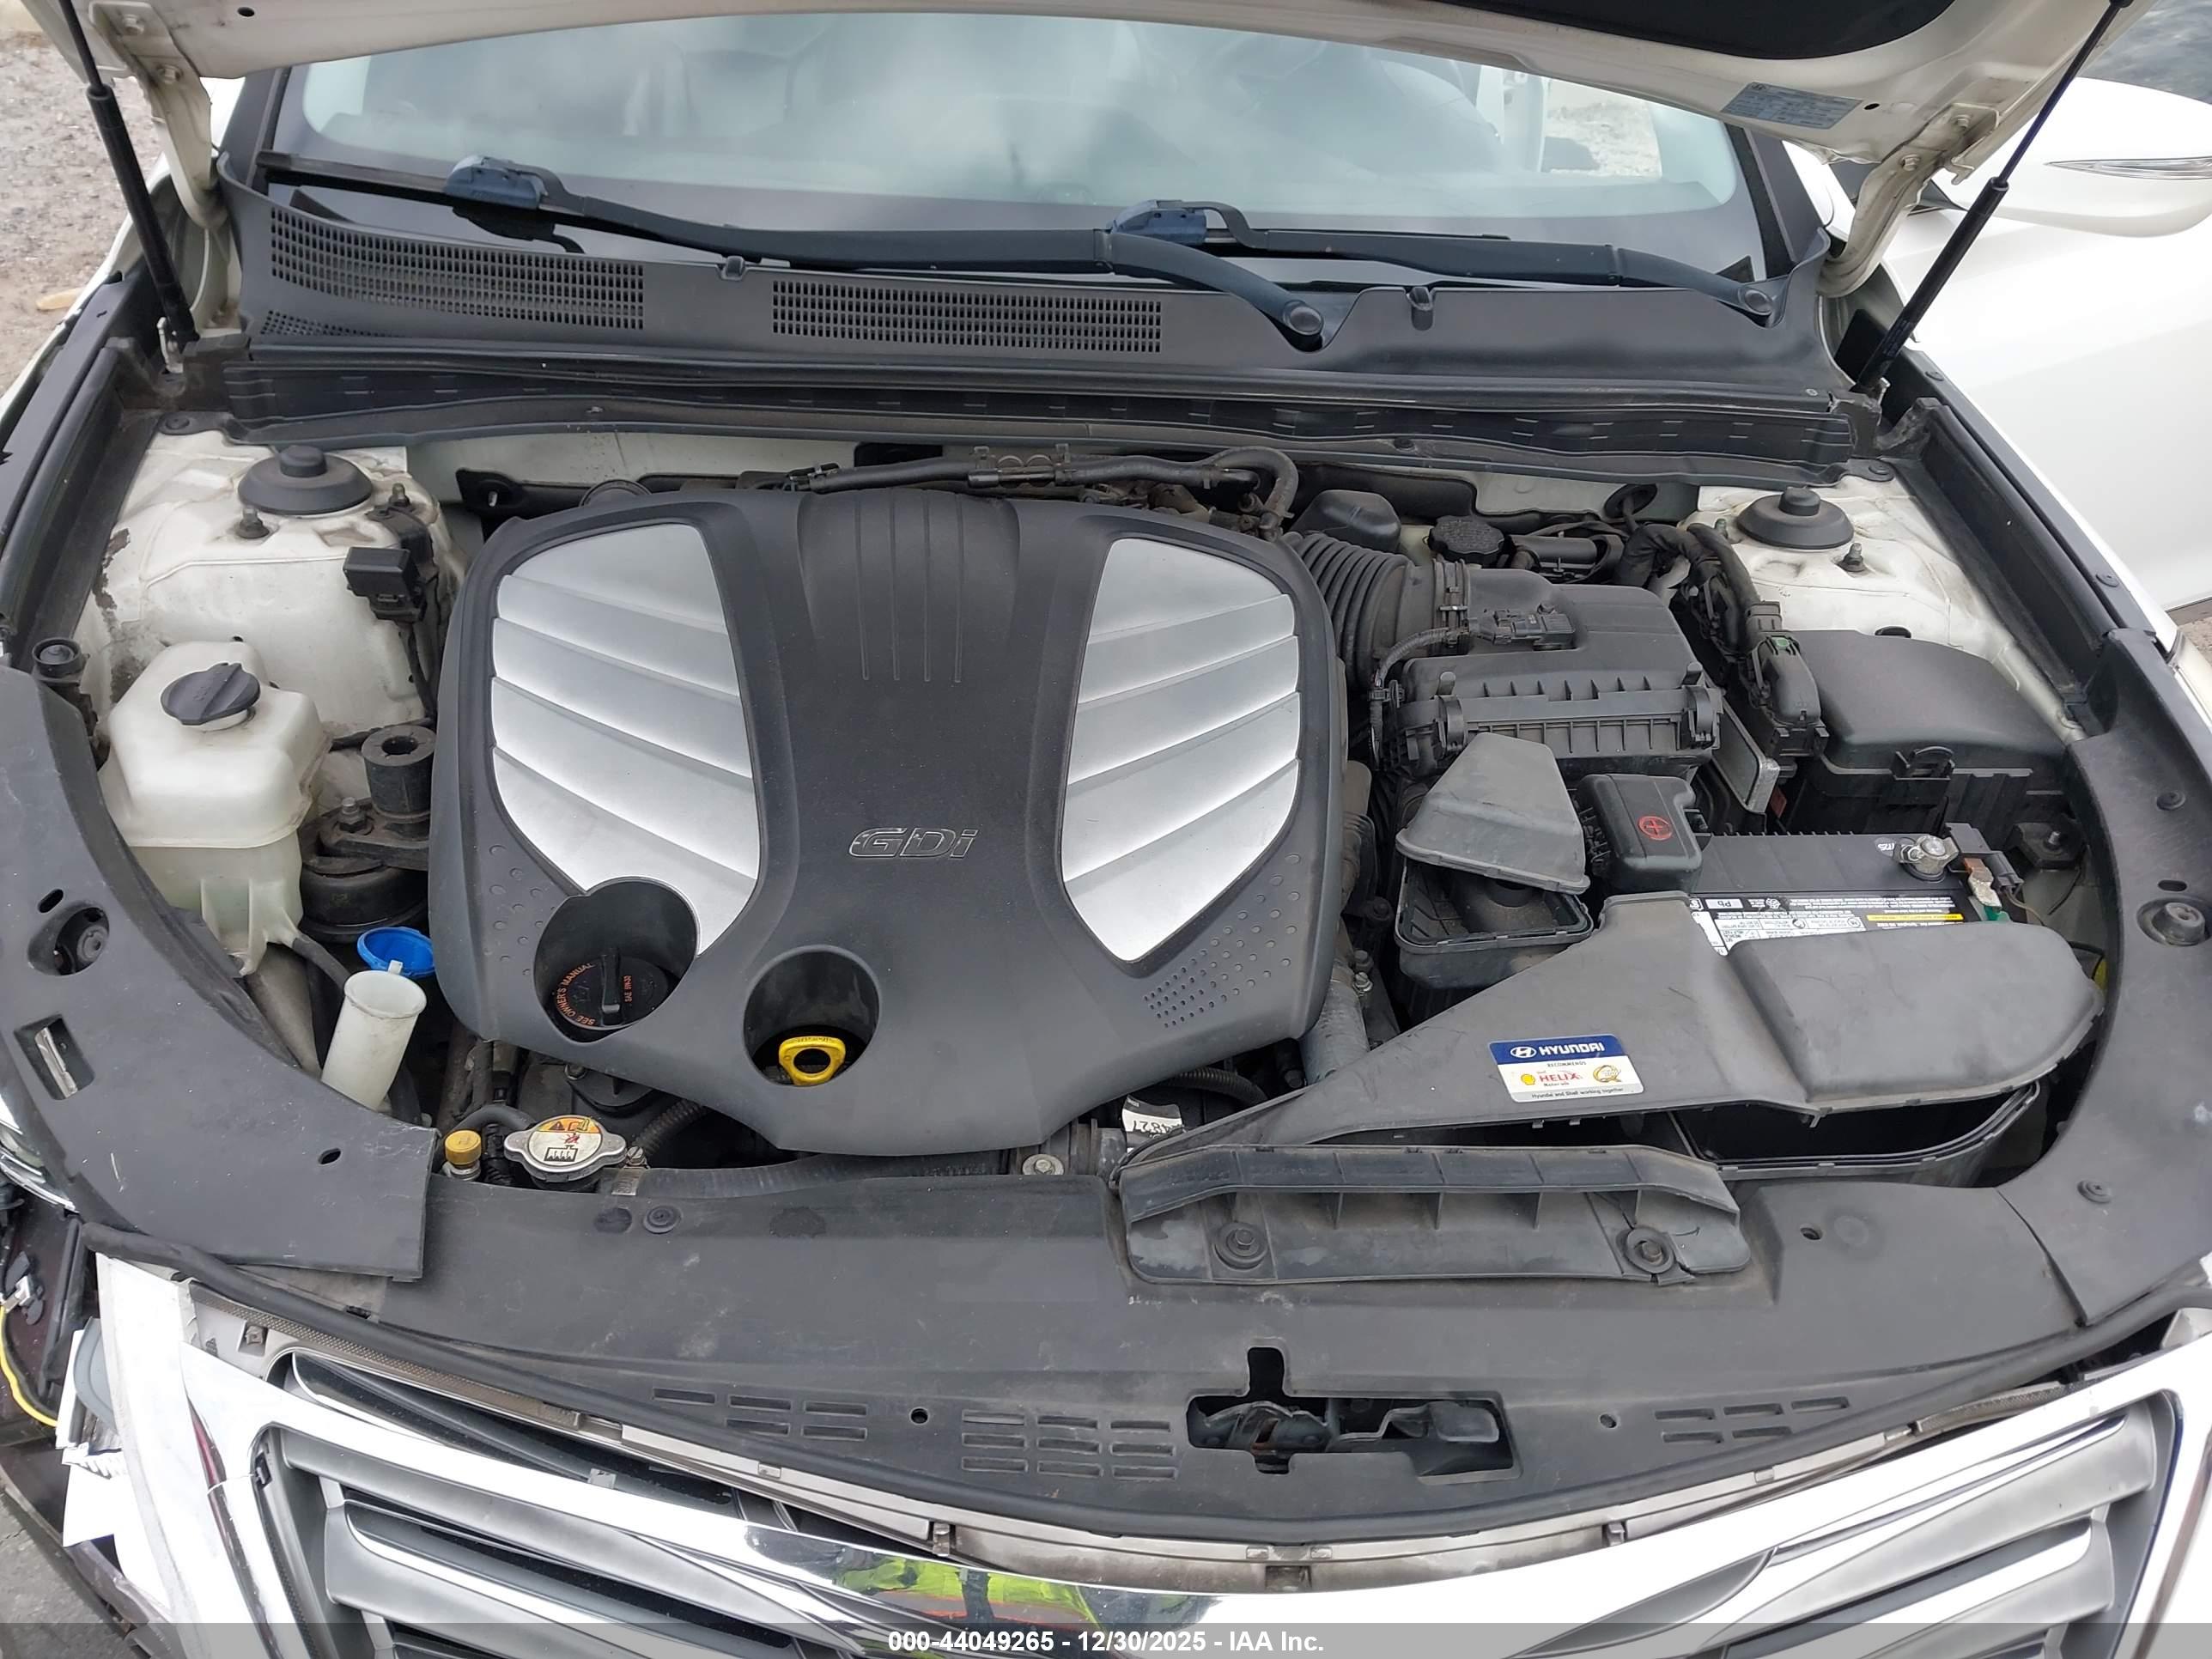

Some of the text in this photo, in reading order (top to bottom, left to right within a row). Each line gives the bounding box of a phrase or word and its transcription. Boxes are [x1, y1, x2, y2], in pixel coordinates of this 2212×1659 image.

[848, 827, 979, 859] GDi
[561, 963, 596, 987] MANUAL
[556, 987, 577, 1018] OWNER'S
[576, 1015, 596, 1026] SEE
[1538, 1042, 1605, 1055] HYUNDAI
[1539, 1073, 1579, 1083] HELIX
